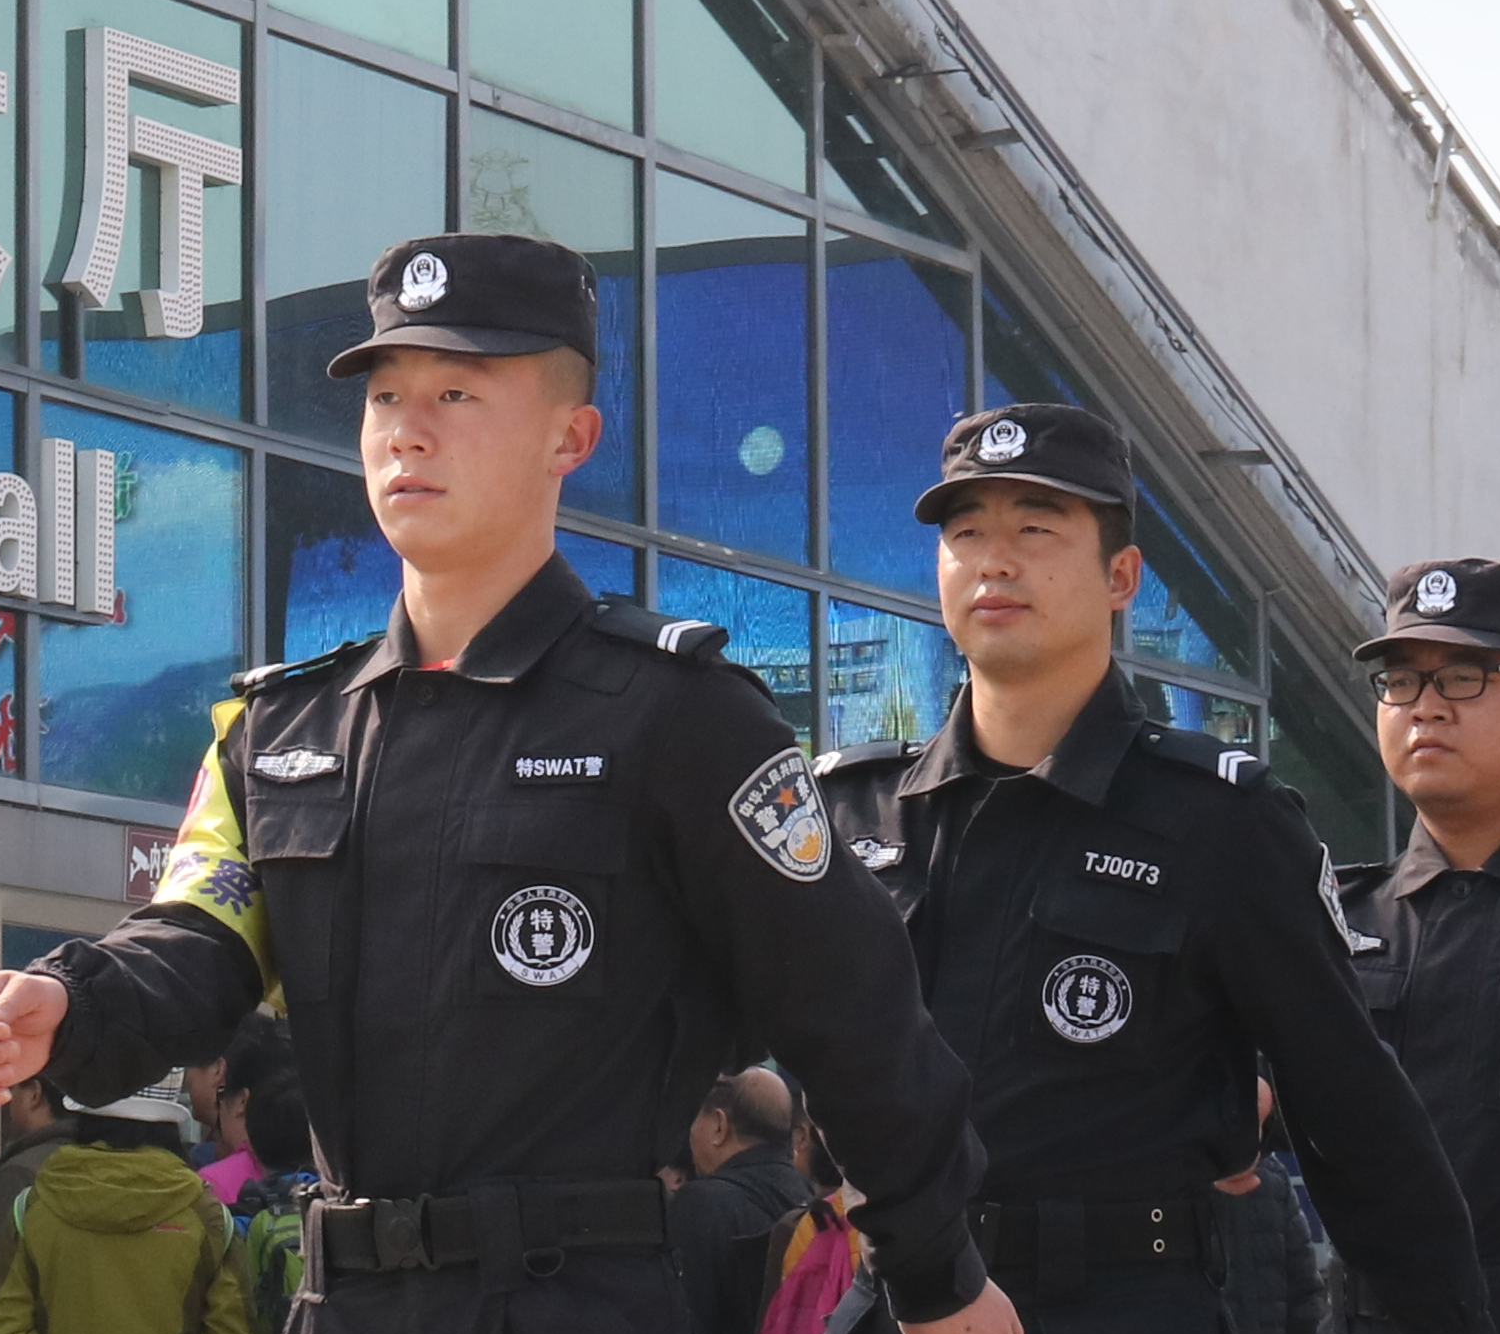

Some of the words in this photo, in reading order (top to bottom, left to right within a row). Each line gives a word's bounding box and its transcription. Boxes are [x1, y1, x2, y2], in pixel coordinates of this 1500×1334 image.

[515, 756, 604, 778] 特SWAT警
[1084, 851, 1161, 886] TJ0073
[529, 908, 555, 957] 特警
[520, 966, 568, 981] SWAT
[1059, 1023, 1101, 1039] SWAT
